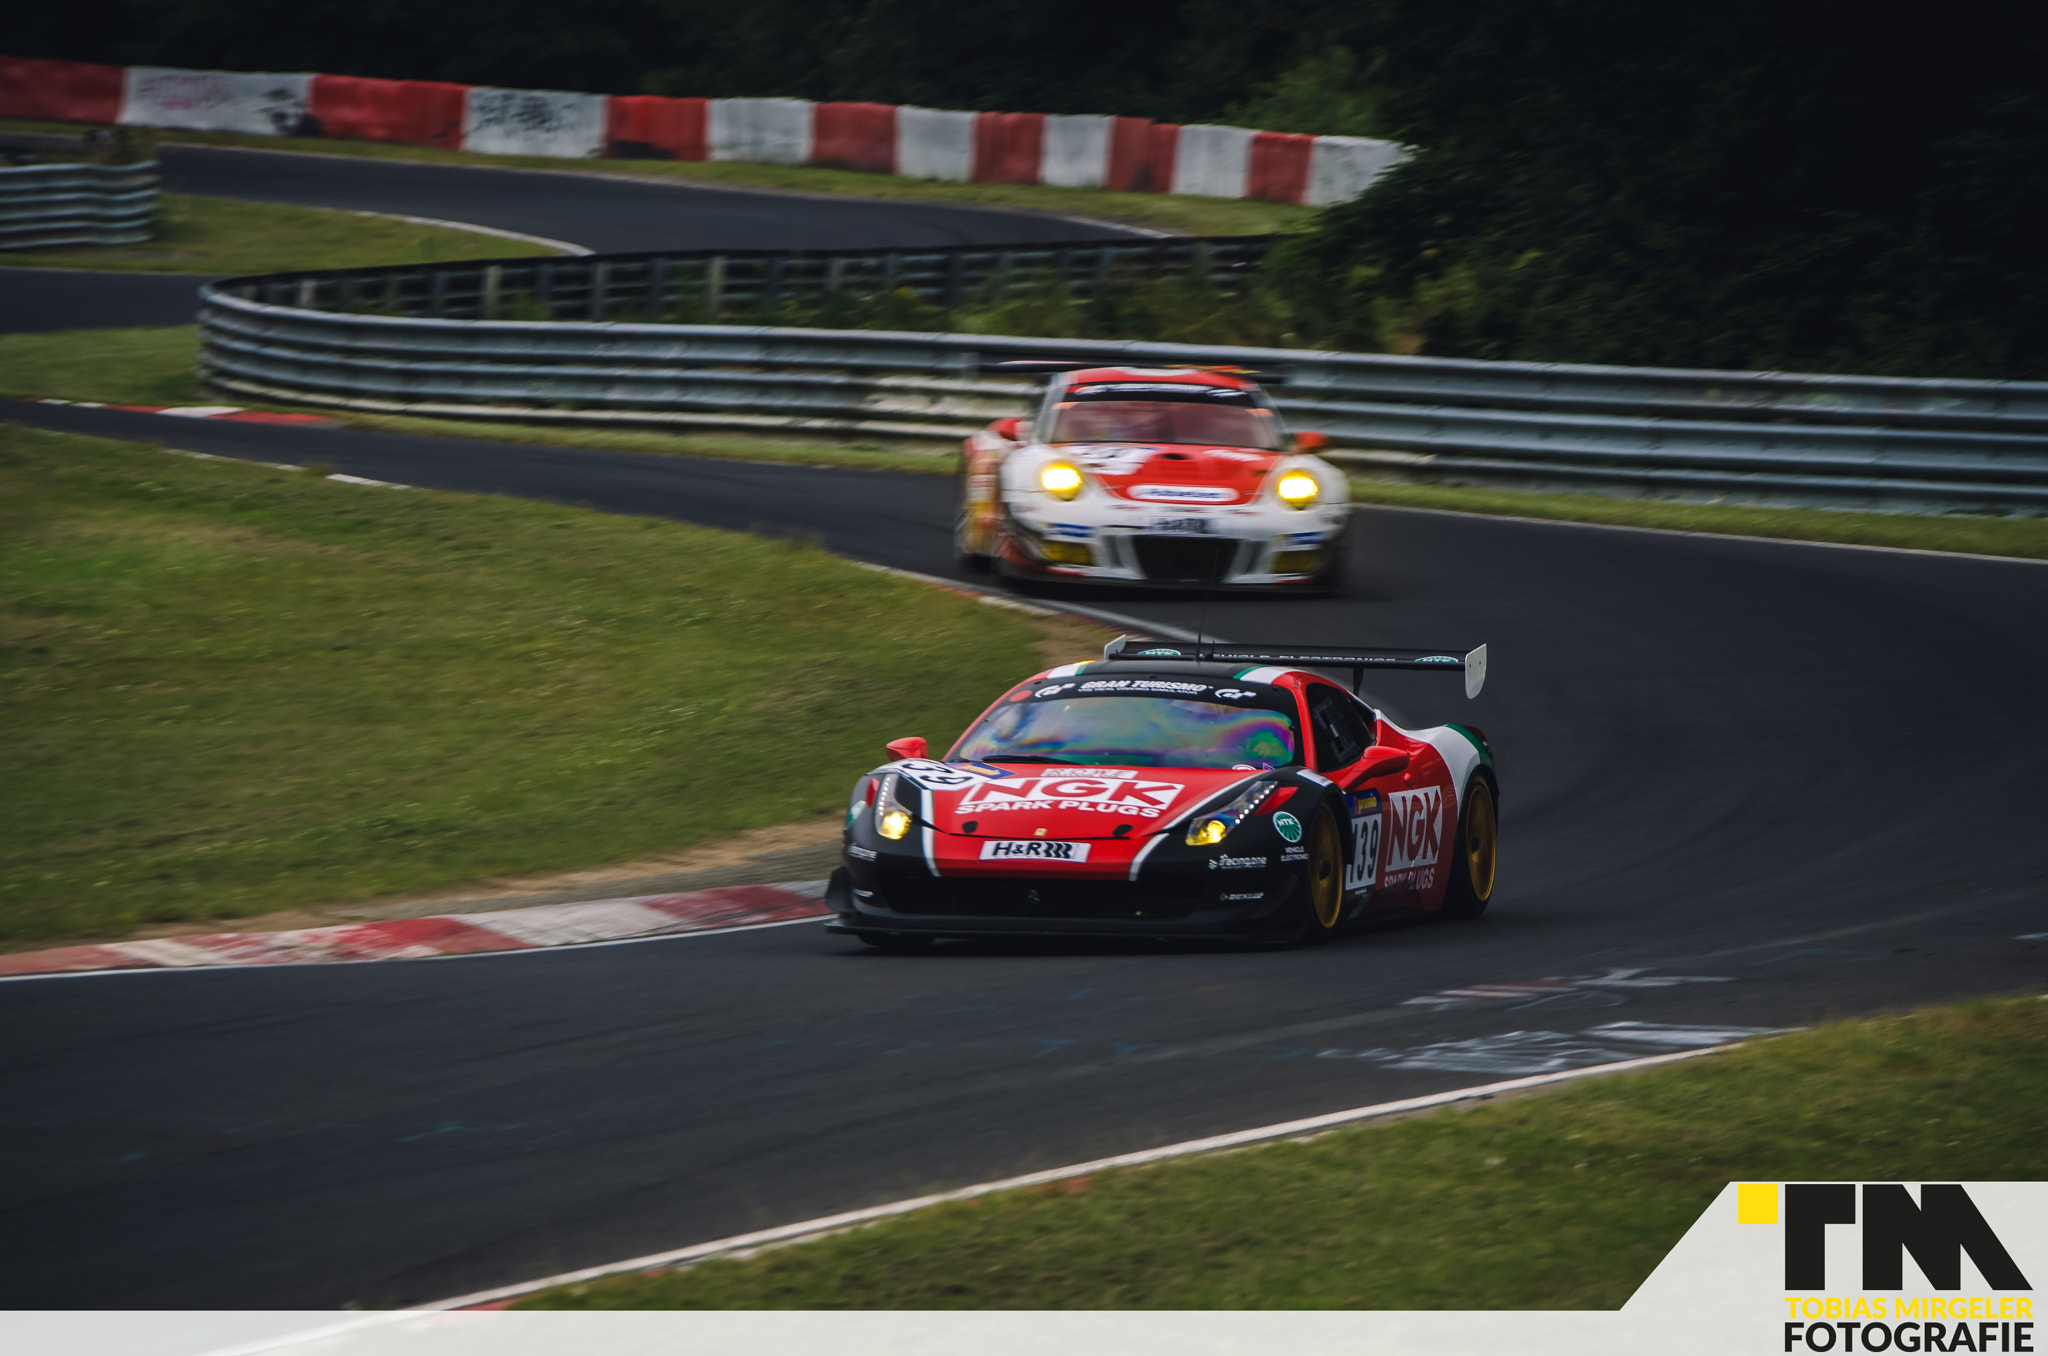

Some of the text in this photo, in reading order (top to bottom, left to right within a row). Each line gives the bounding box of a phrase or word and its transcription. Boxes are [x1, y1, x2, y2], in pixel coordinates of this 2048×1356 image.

[1080, 680, 1207, 692] GRAN TURISMO
[966, 778, 1180, 808] NGK
[954, 800, 1161, 818] SPARK PLUGS
[1277, 815, 1296, 826] NTK
[1387, 788, 1442, 866] NGK
